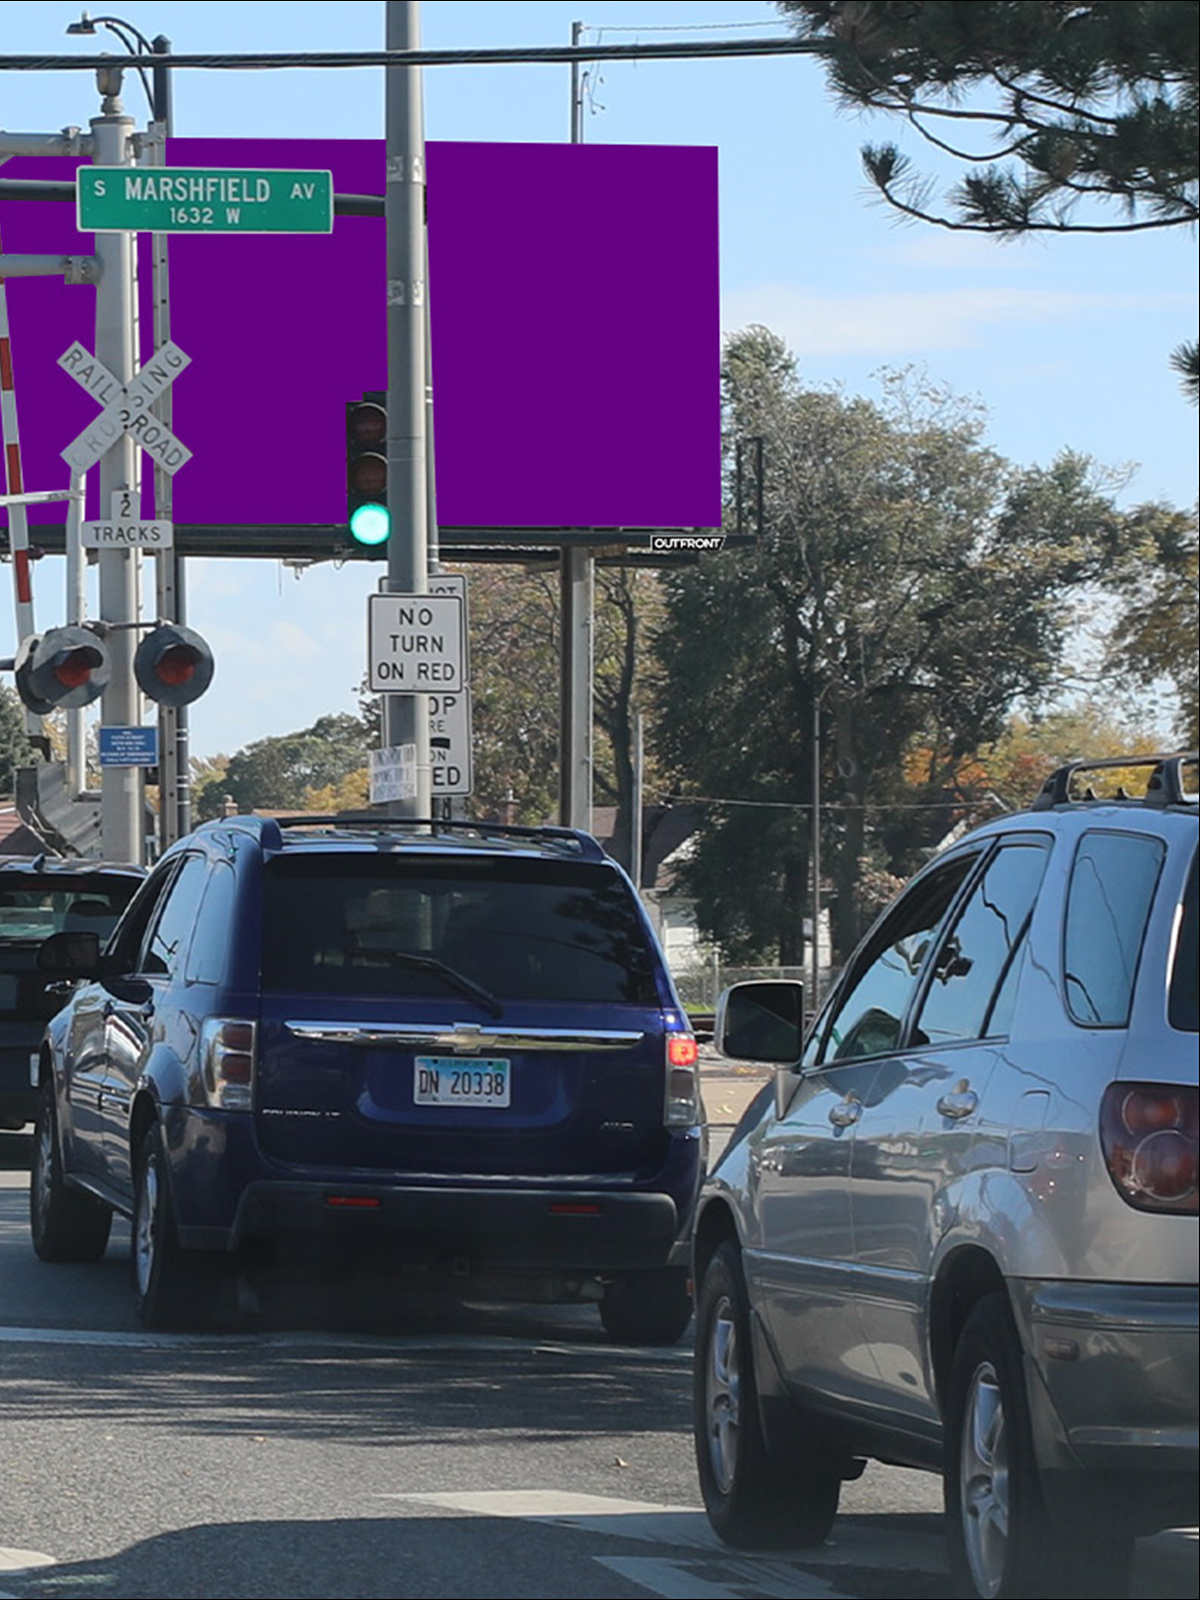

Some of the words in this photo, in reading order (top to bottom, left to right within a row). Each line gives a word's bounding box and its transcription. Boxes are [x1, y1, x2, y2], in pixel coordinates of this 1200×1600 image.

[93, 180, 107, 196] S
[124, 177, 271, 202] MARSHFIELD
[290, 183, 315, 199] AV
[170, 207, 214, 224] 1632
[226, 208, 241, 224] W
[63, 349, 113, 405] RAIL
[129, 414, 184, 467] ROAD
[120, 499, 132, 518] 2
[93, 526, 161, 542] TRACKS
[654, 537, 721, 549] OUTFRONT
[399, 608, 433, 626] NO
[389, 635, 444, 653] TURN
[377, 662, 404, 680] ON
[417, 663, 455, 681] RED
[429, 696, 457, 716] OP
[430, 720, 445, 733] RE
[433, 766, 461, 786] ED
[418, 1069, 440, 1095] DN
[450, 1071, 505, 1096] 20338
